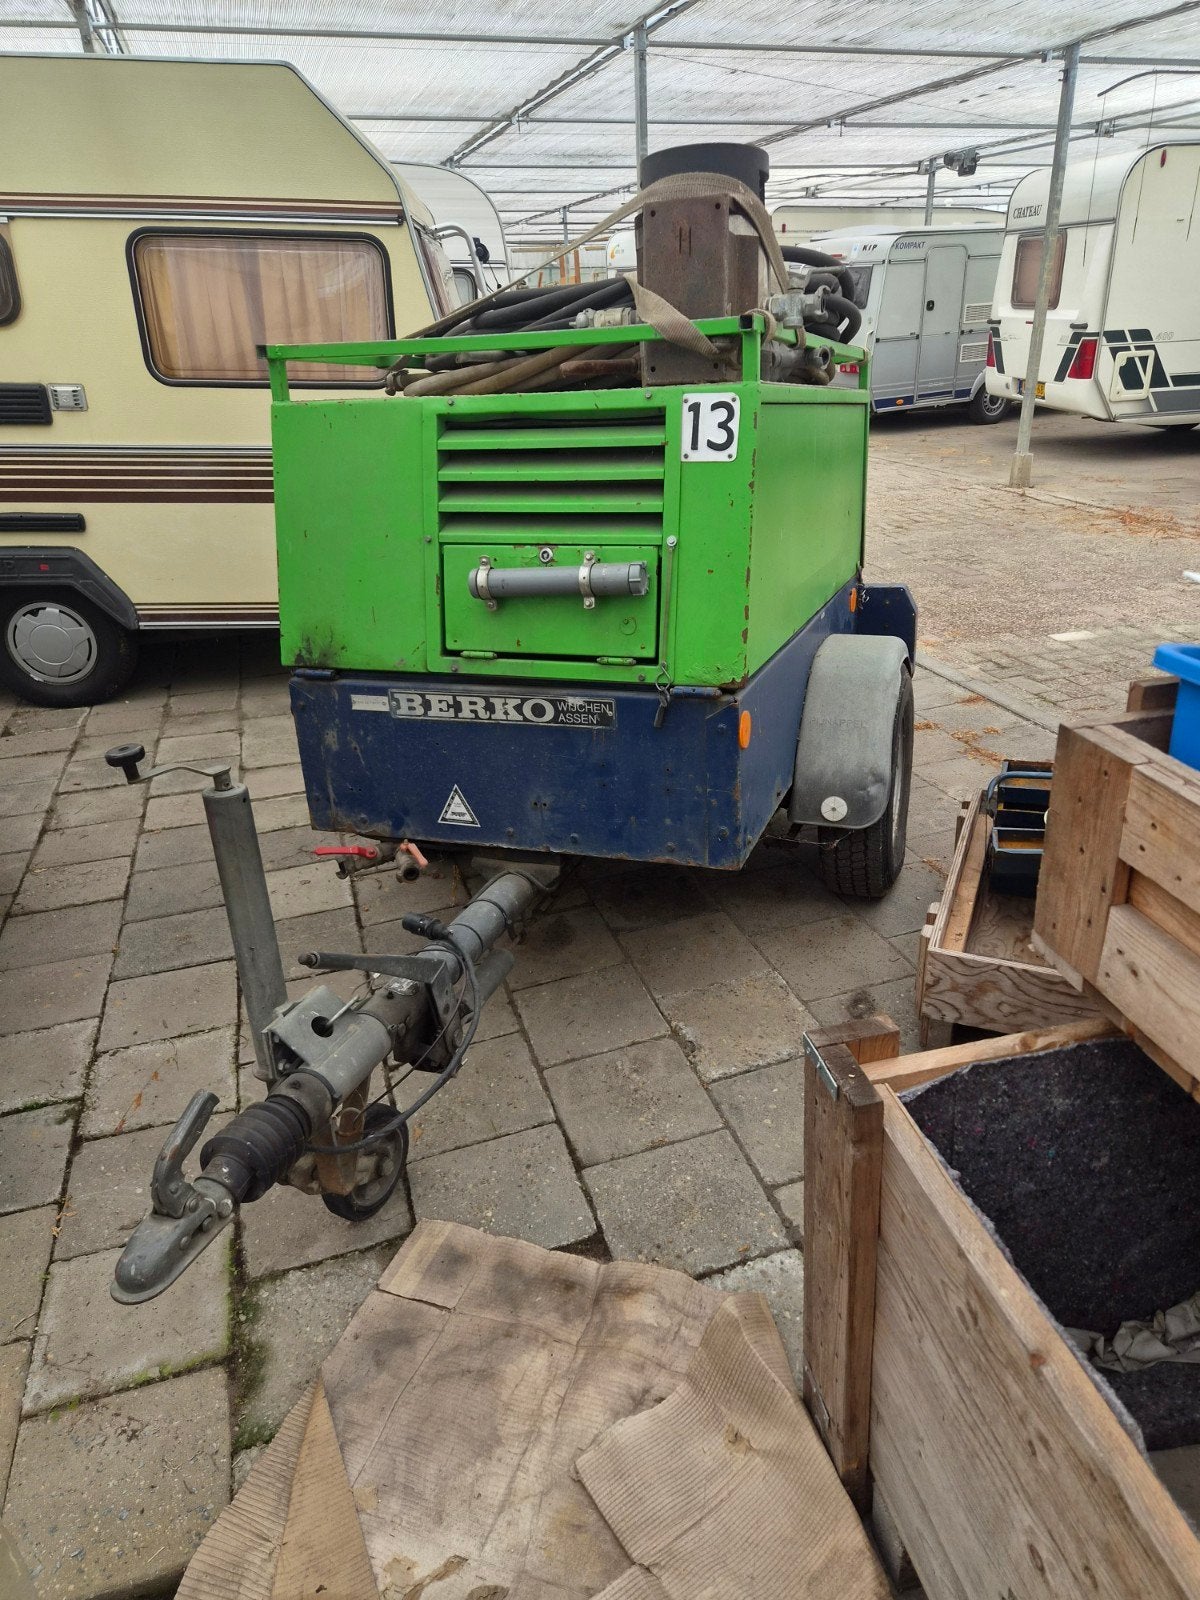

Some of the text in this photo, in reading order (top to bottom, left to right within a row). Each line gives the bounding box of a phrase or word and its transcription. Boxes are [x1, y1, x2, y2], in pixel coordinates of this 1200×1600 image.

[1012, 204, 1042, 219] CHATEAU
[895, 241, 926, 250] KOMPAKT
[688, 401, 735, 451] 13
[393, 692, 555, 722] BERKO
[557, 701, 610, 714] WIJCHEN
[558, 713, 597, 724] ASSEN
